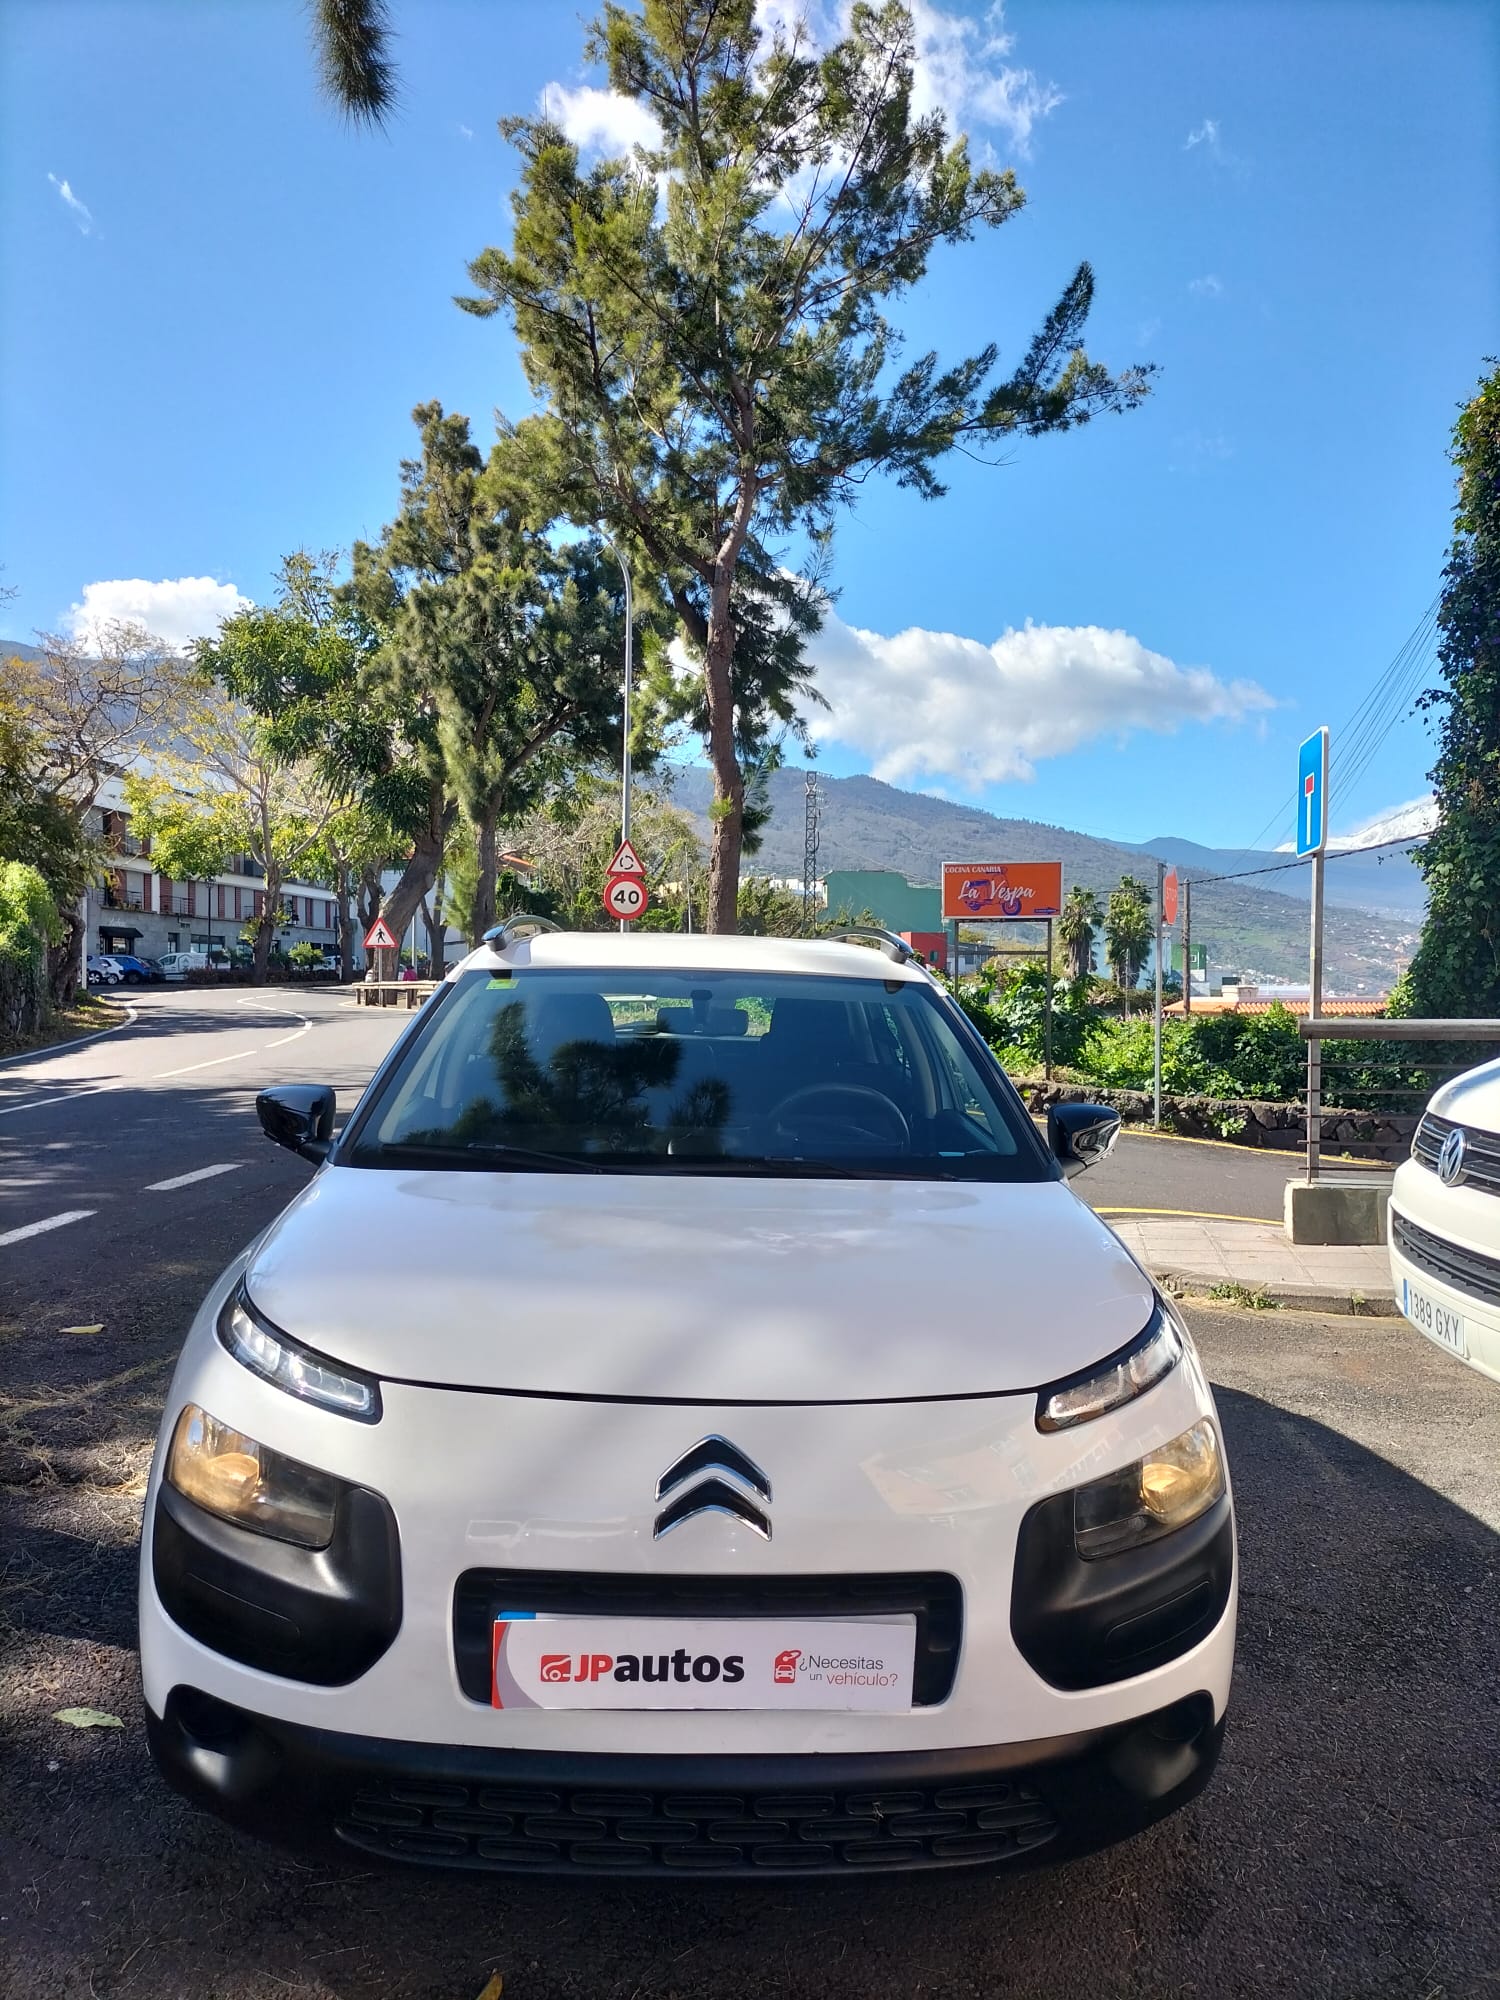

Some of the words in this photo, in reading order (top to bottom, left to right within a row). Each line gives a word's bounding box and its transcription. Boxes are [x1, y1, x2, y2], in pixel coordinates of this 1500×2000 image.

[945, 866, 970, 874] COCINA
[613, 890, 640, 905] 40
[958, 880, 980, 900] La
[989, 880, 1036, 906] Vespa
[1166, 887, 1177, 903] STOP
[1409, 1289, 1432, 1329] 1389
[1435, 1308, 1459, 1346] GXY
[573, 1648, 745, 1684] JPautos
[799, 1655, 884, 1671] ¿Necesitas
[809, 1673, 823, 1681] un
[826, 1672, 898, 1687] vehículo?
